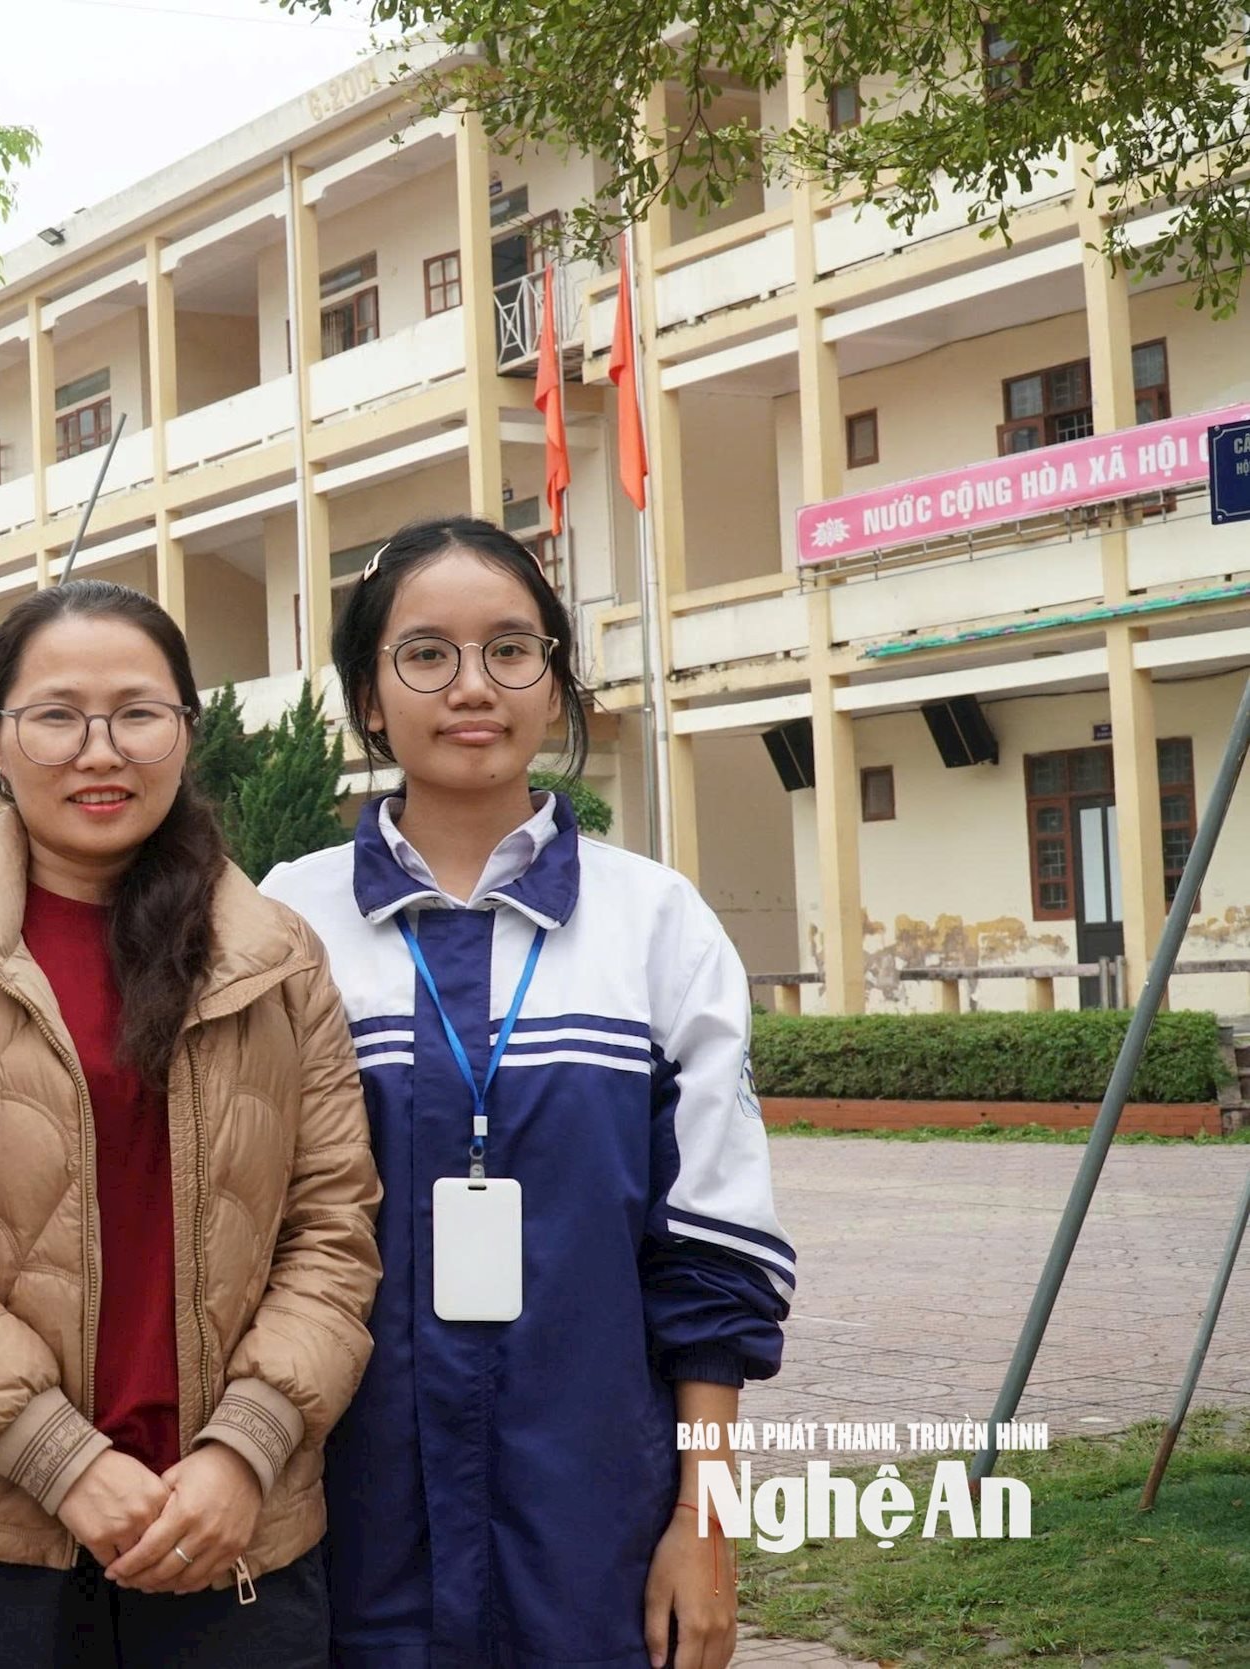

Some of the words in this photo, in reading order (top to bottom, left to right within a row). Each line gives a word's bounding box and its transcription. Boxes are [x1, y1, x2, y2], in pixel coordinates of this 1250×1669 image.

[863, 493, 932, 536] NƯỚC
[940, 478, 1012, 520] CỘNG
[1021, 460, 1078, 500] HÒA
[1089, 445, 1127, 486] XÃ
[1138, 434, 1188, 477] HỘI
